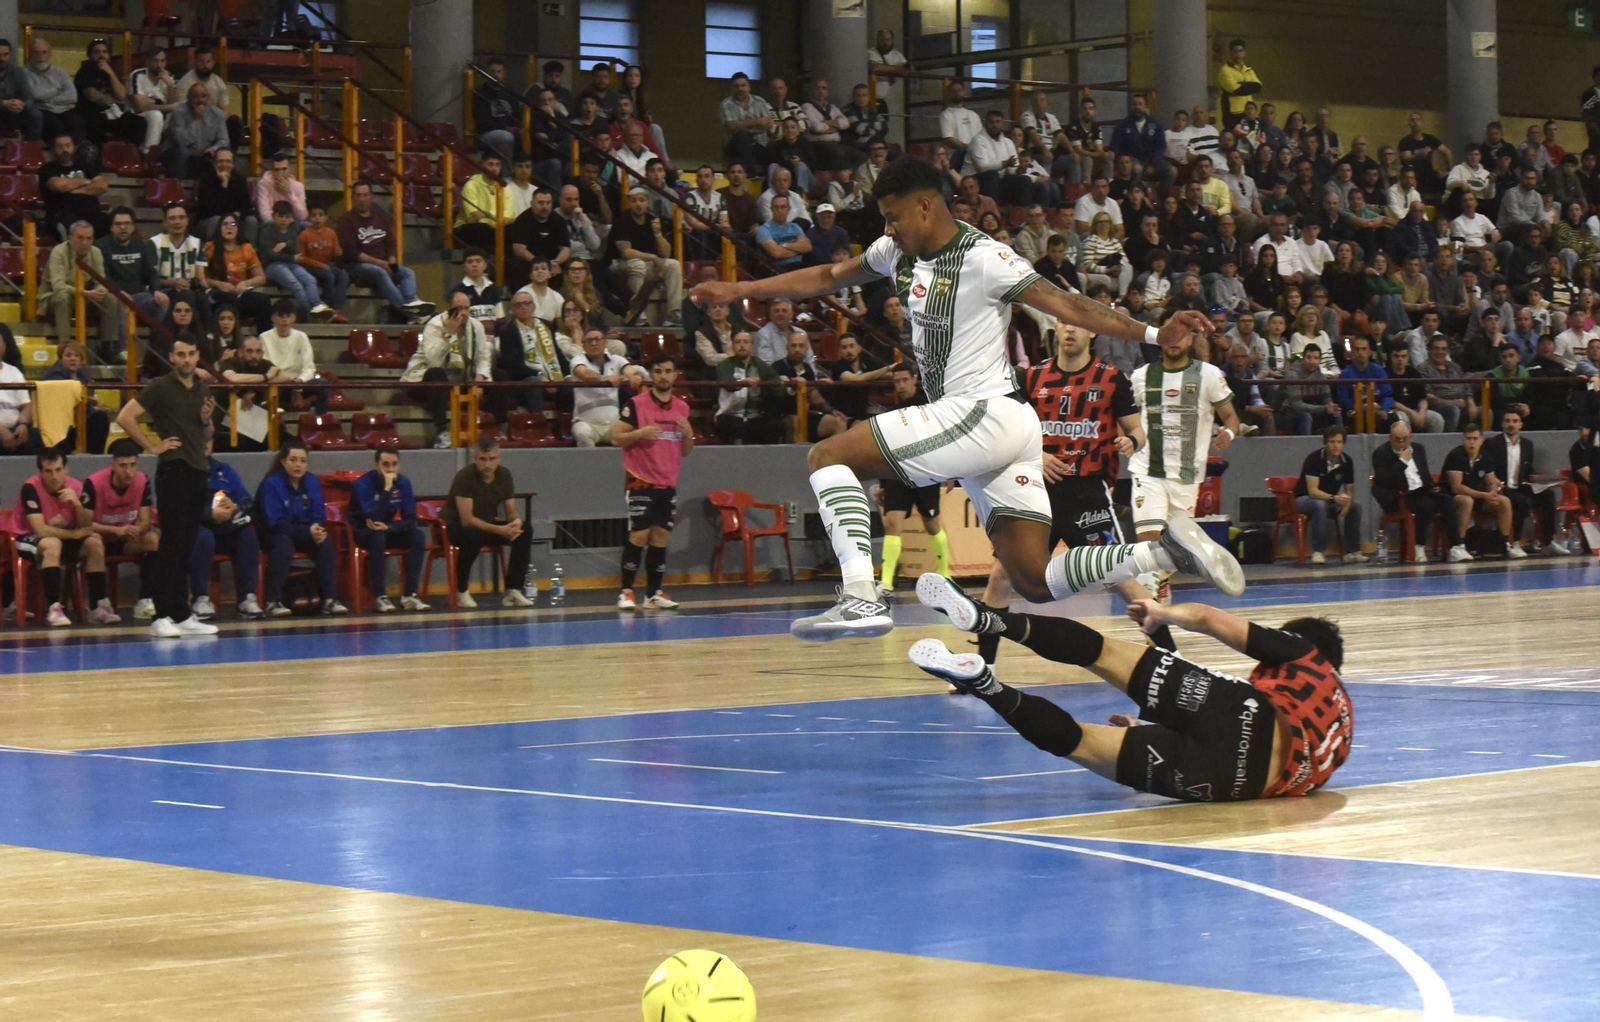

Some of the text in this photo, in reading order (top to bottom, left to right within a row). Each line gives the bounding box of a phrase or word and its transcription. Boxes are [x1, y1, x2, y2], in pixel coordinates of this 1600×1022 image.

[1059, 395, 1072, 415] 21
[1147, 654, 1175, 710] D-Link
[1177, 675, 1196, 706] SUSHI
[1191, 675, 1212, 702] ENJOY
